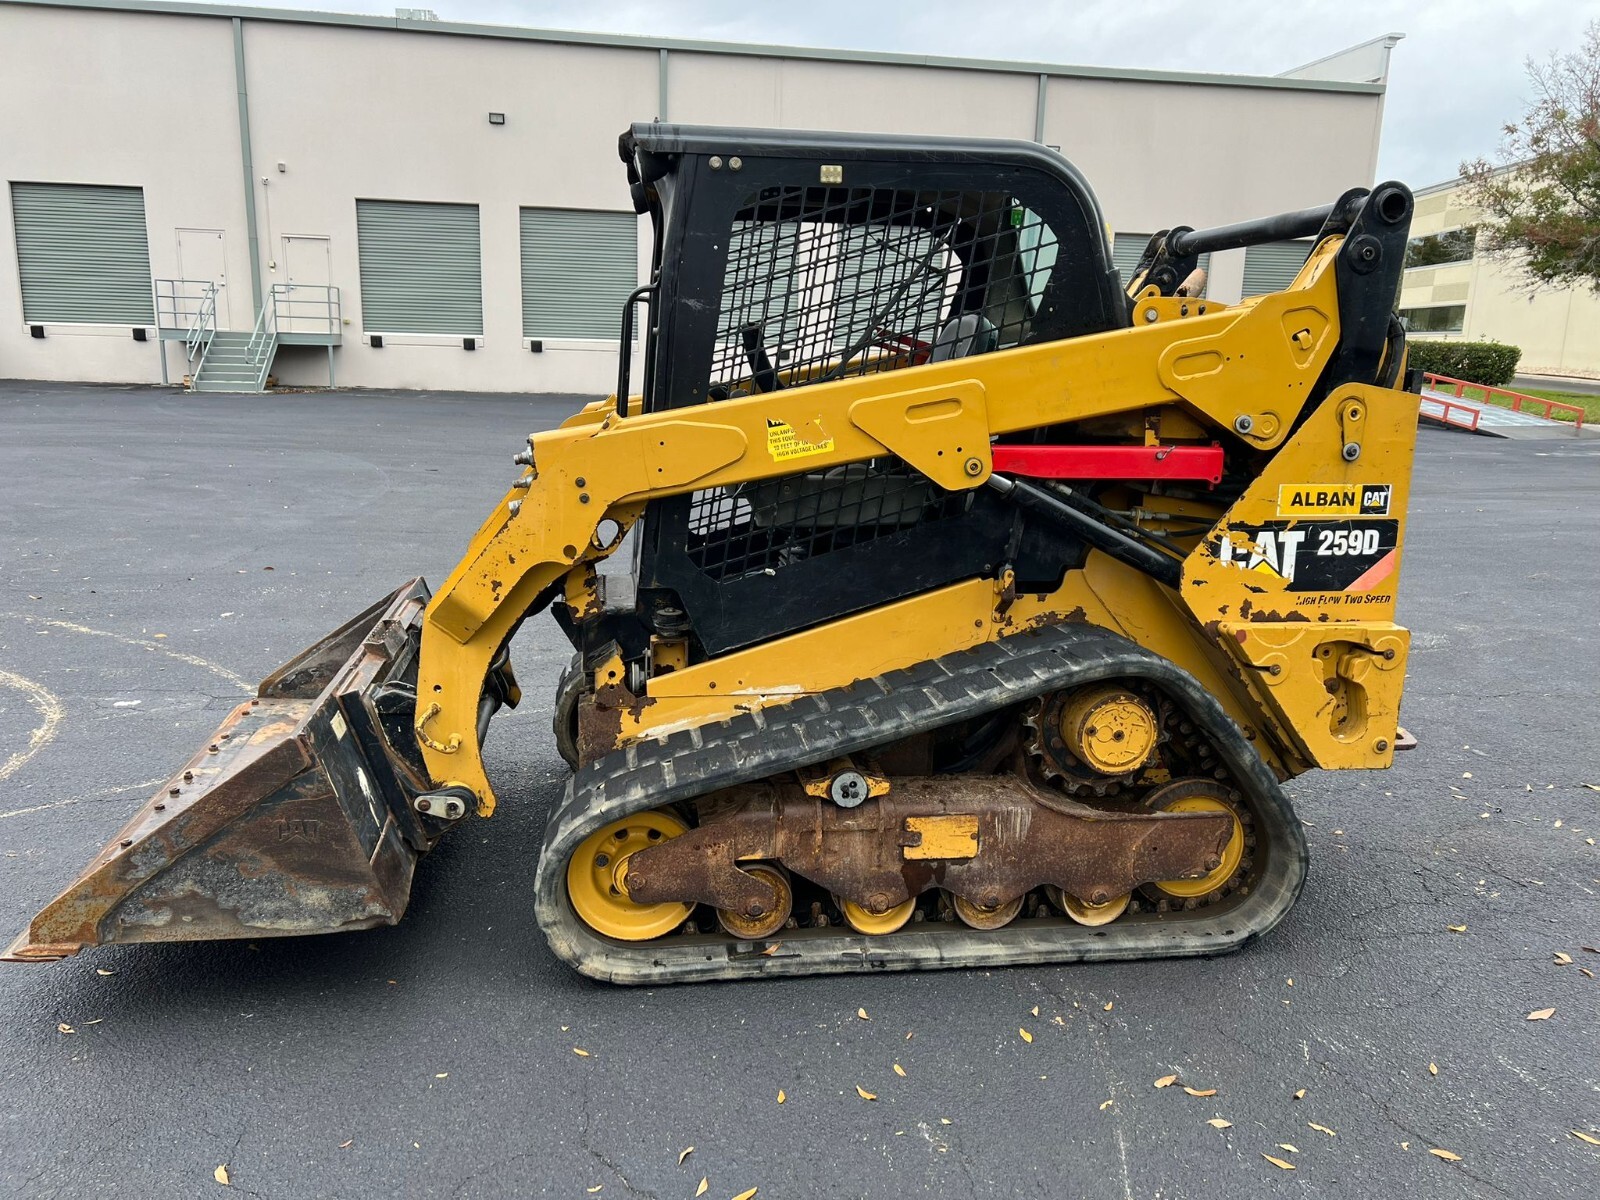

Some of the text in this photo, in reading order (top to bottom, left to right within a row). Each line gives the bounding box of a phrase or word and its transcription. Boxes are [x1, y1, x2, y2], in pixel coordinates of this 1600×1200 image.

[790, 446, 811, 455] VOLTAGE
[1290, 491, 1387, 507] ALBAN CAT
[1317, 530, 1380, 556] 259D
[1344, 595, 1363, 605] TWO
[1364, 593, 1391, 604] SPEED
